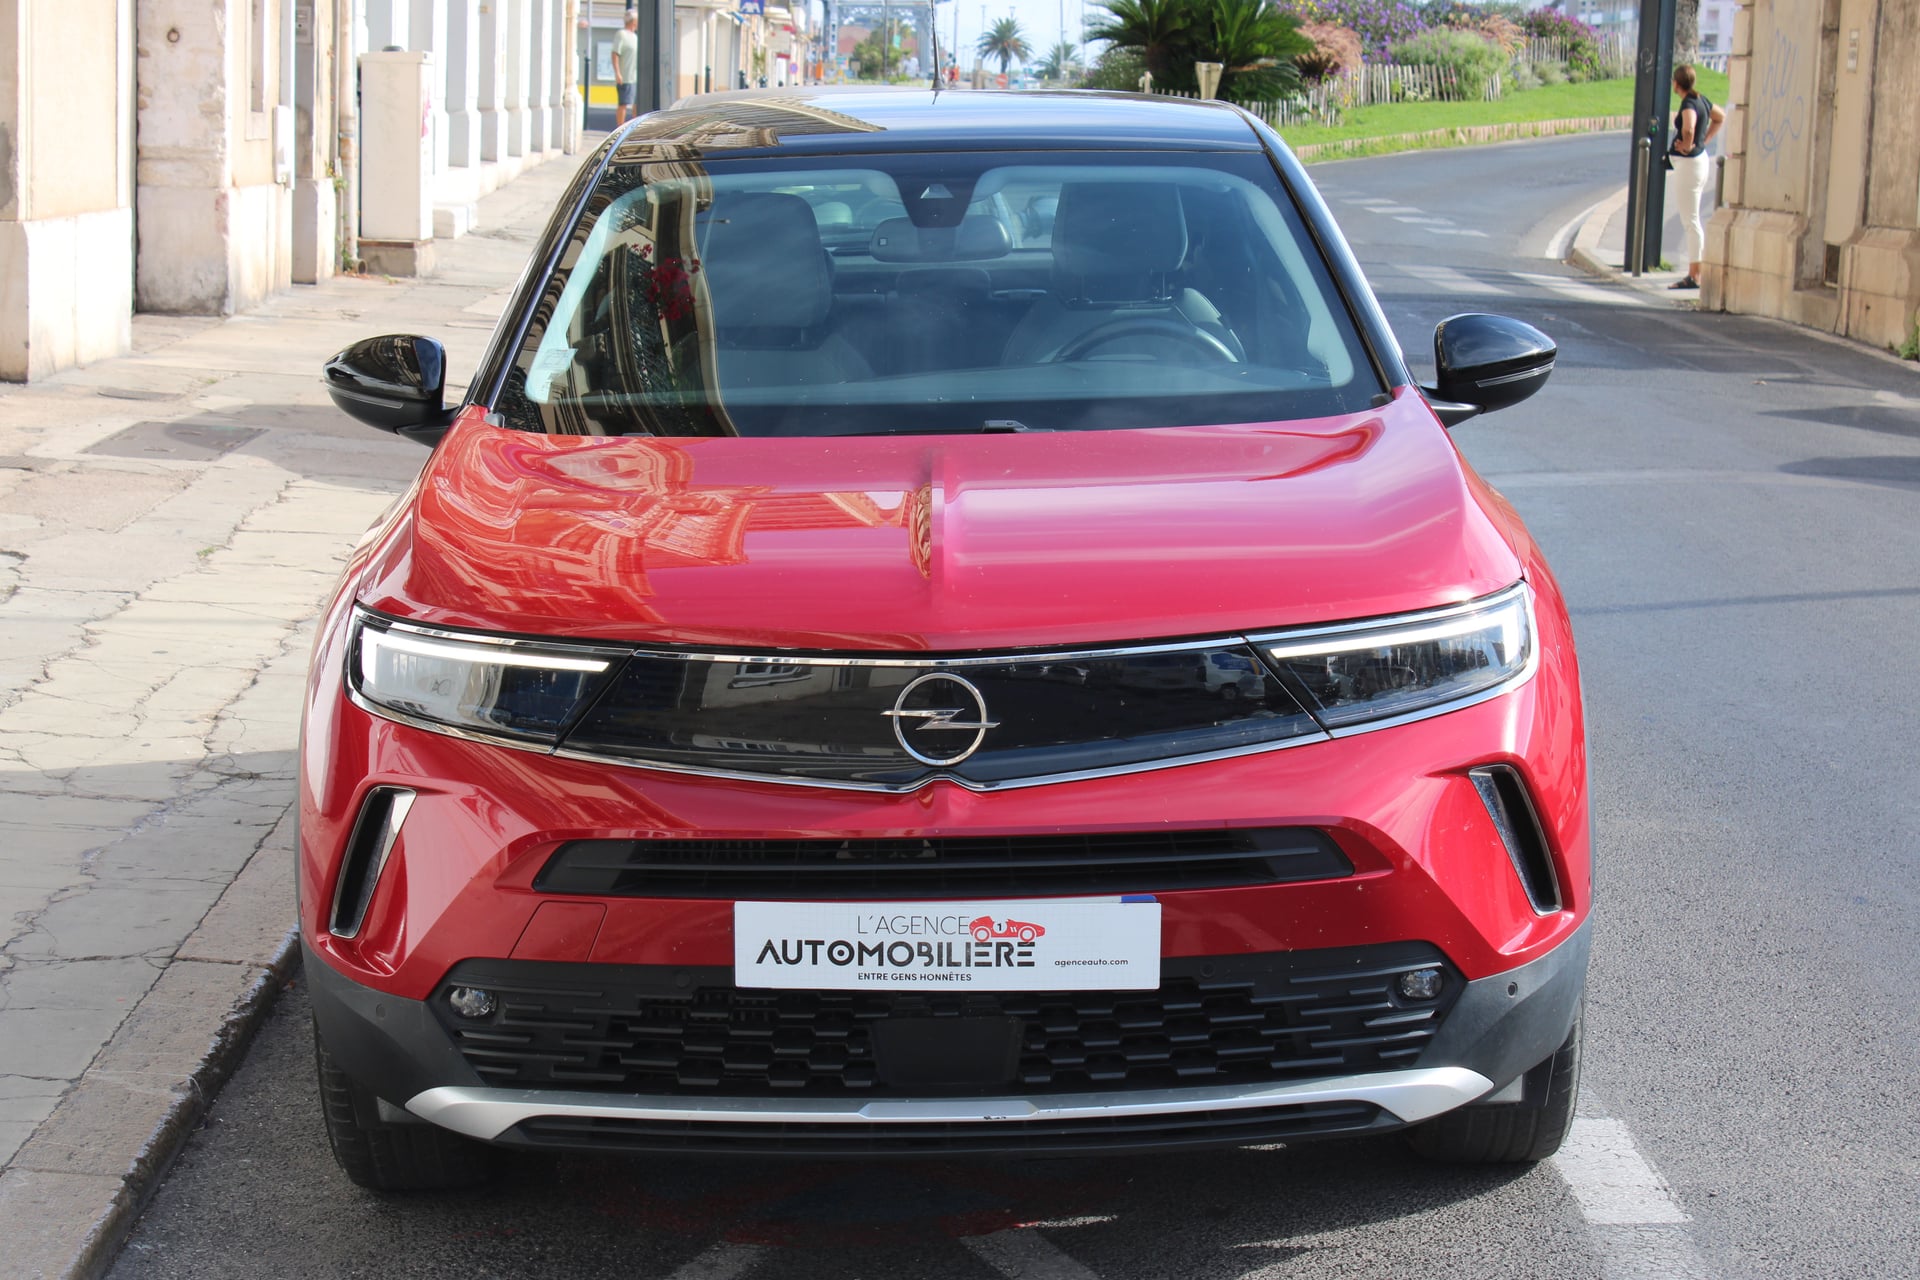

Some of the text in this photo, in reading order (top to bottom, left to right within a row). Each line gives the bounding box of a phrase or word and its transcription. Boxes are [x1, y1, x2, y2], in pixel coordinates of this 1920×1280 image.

[857, 915, 970, 935] L'AGENCE
[1054, 958, 1129, 968] agenceauto.com
[858, 971, 972, 982] ENTRE GENS HONNÊTES
